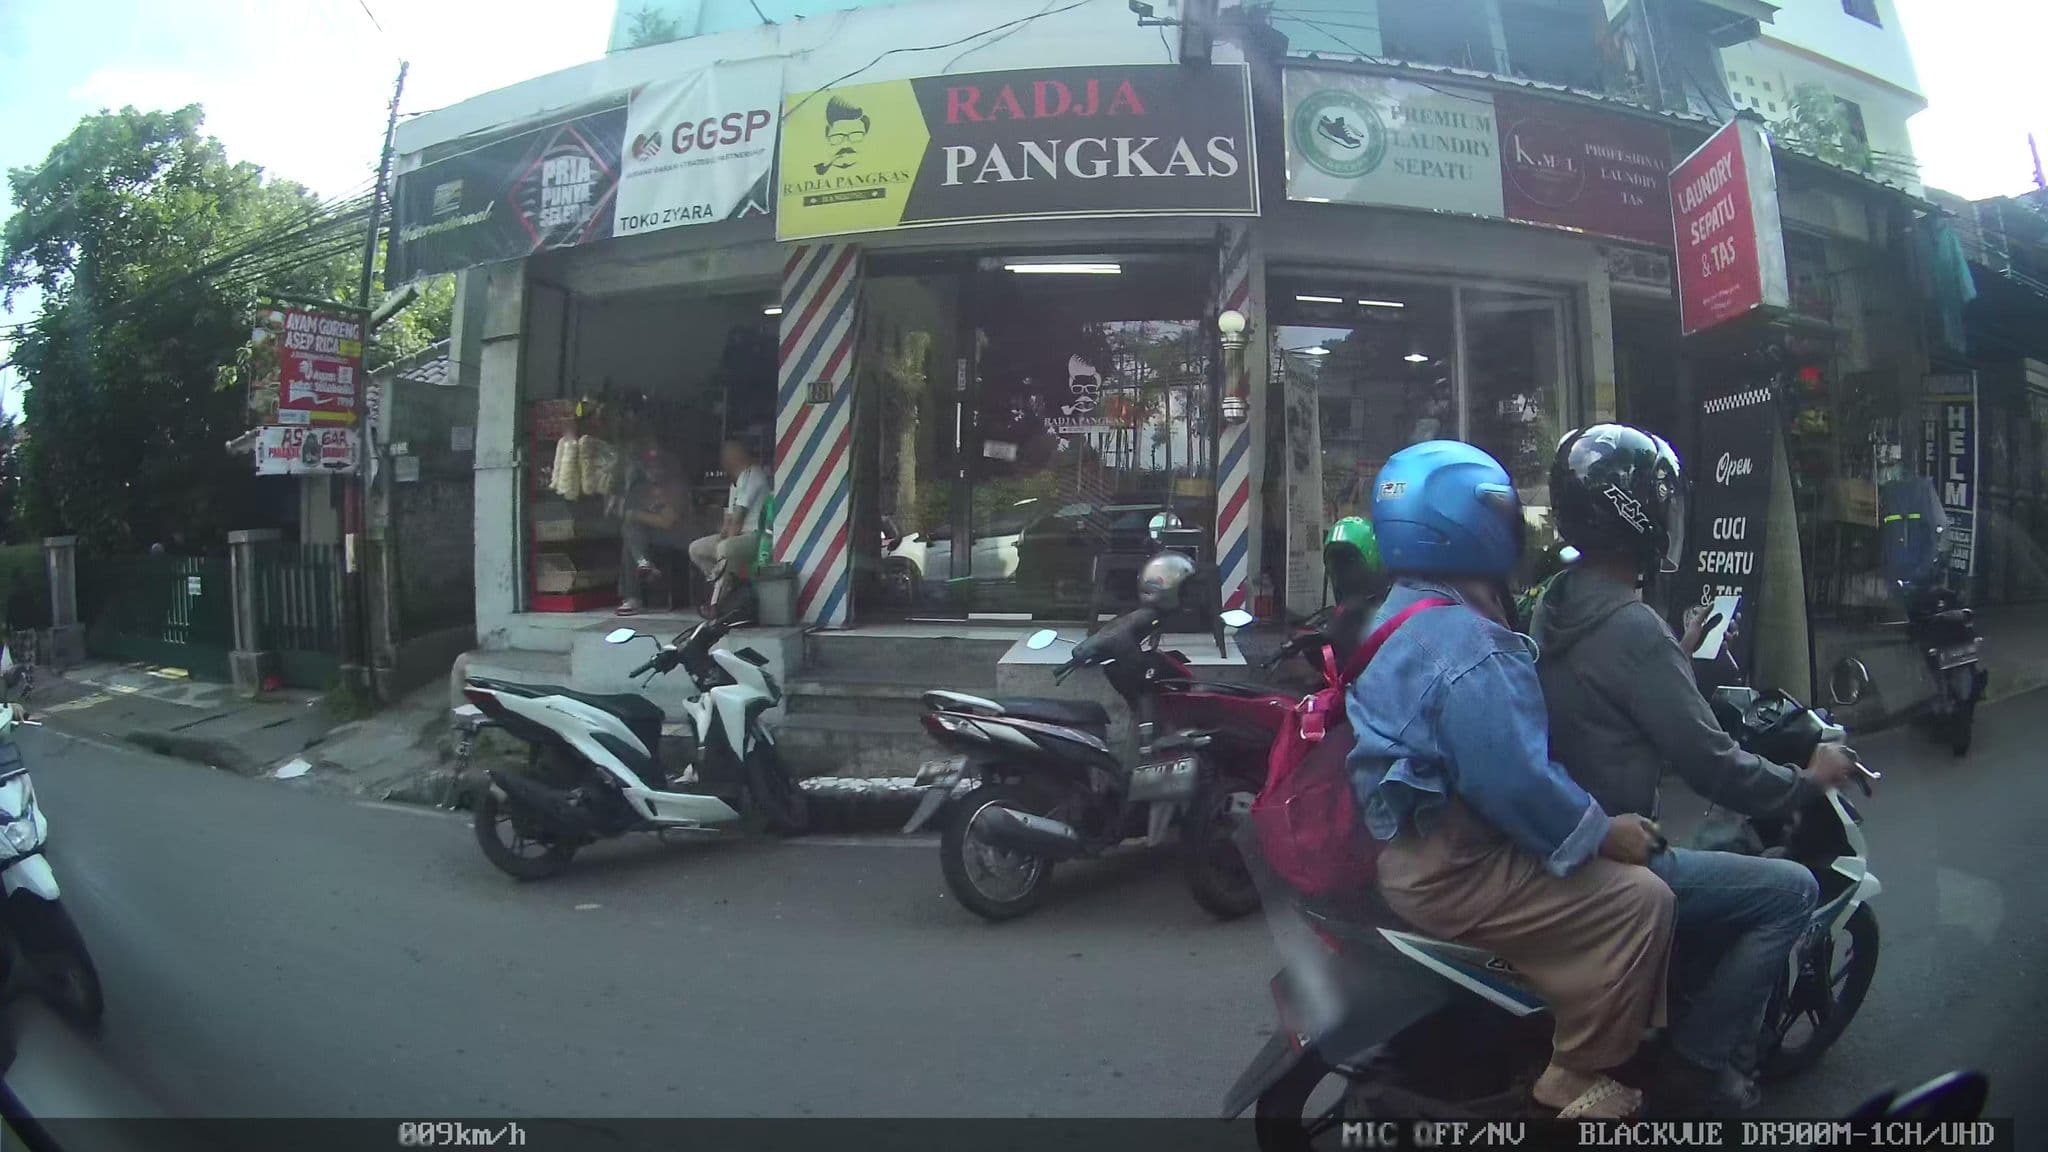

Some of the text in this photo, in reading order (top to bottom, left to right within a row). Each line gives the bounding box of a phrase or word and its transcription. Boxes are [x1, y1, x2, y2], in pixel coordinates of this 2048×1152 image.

[946, 79, 1145, 125] RADJA
[1390, 104, 1491, 132] PREMIUM
[671, 109, 771, 154] GGSP
[1390, 131, 1491, 157] LAUNDRY
[542, 156, 591, 188] PRIA
[941, 136, 1238, 186] PANGKAS
[1394, 157, 1472, 181] SEPATU
[1678, 151, 1733, 215] LAUNDRY
[620, 203, 714, 232] TOKO ZYARA
[1691, 193, 1736, 247] SEPATU
[1702, 236, 1736, 278] & TAS
[285, 331, 313, 350] ASEP
[287, 313, 359, 339] AYAM GORENG
[1716, 452, 1753, 486] Open
[1945, 406, 1967, 507] HELM
[1713, 517, 1746, 540] CUCI
[1698, 551, 1754, 575] SEPATU
